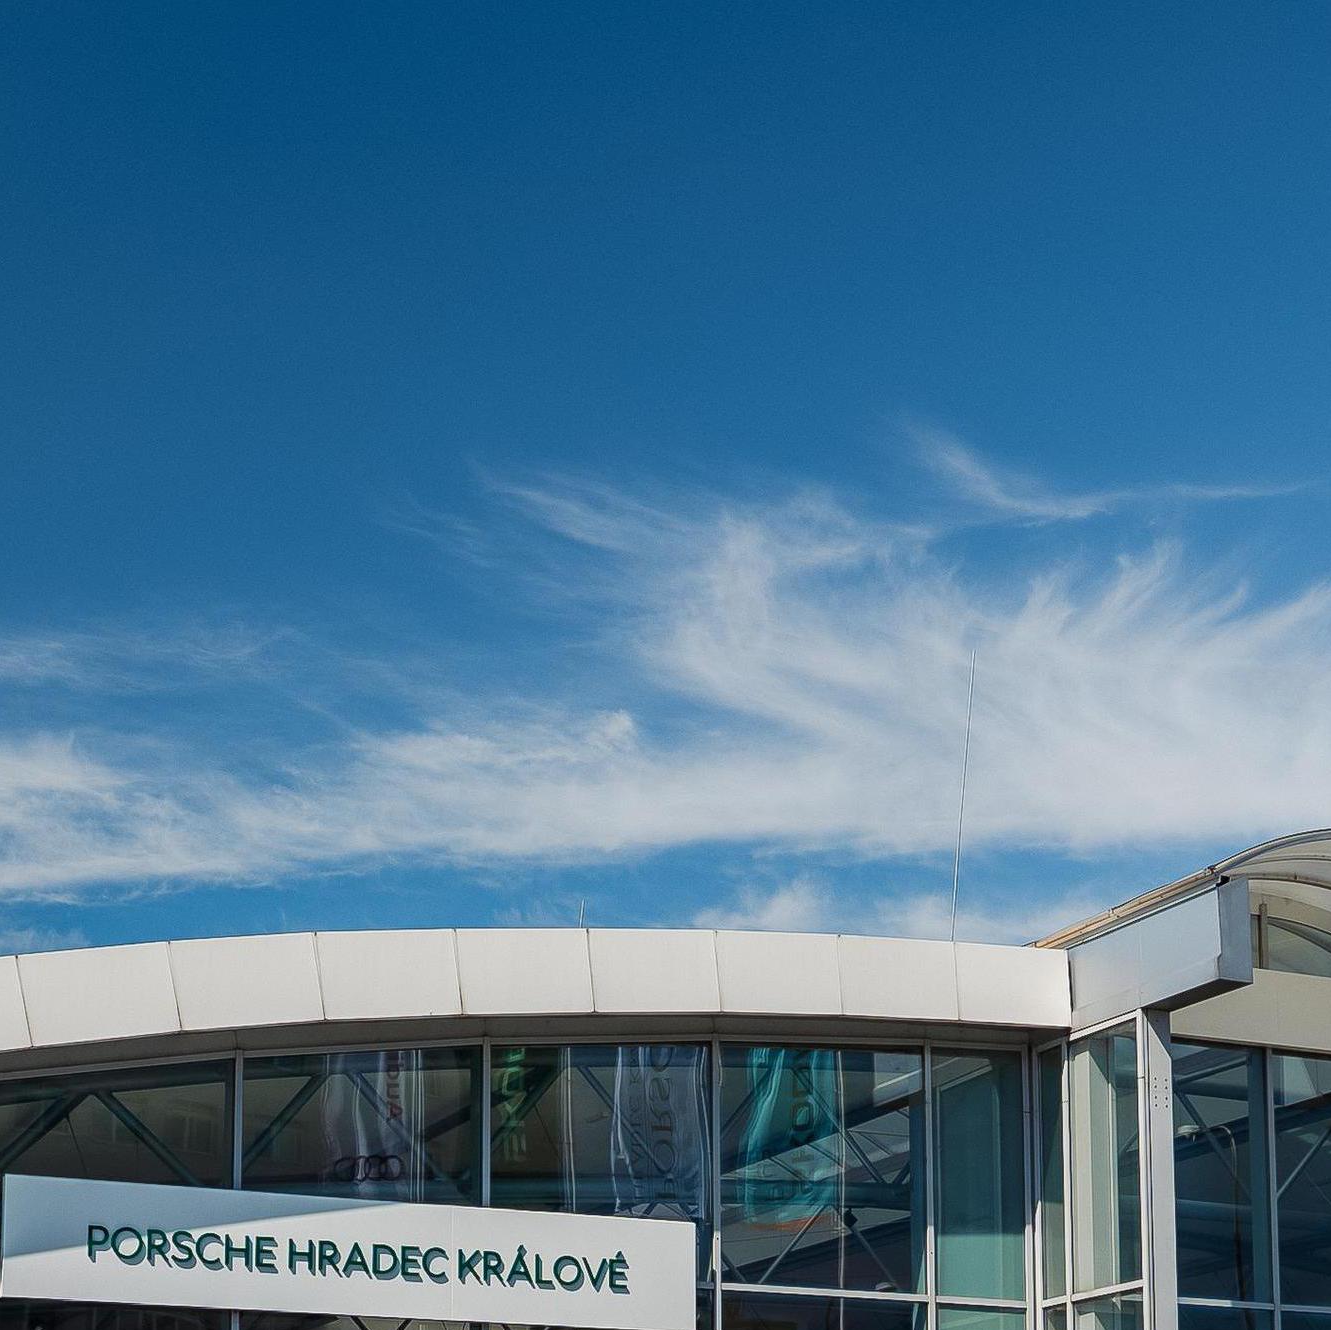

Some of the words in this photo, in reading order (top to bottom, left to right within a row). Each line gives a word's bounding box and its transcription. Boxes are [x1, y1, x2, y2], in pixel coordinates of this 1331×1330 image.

[87, 1225, 278, 1274] PORSCHE
[288, 1239, 449, 1284] HRADEC
[457, 1244, 630, 1295] KRÁLOVÉ
